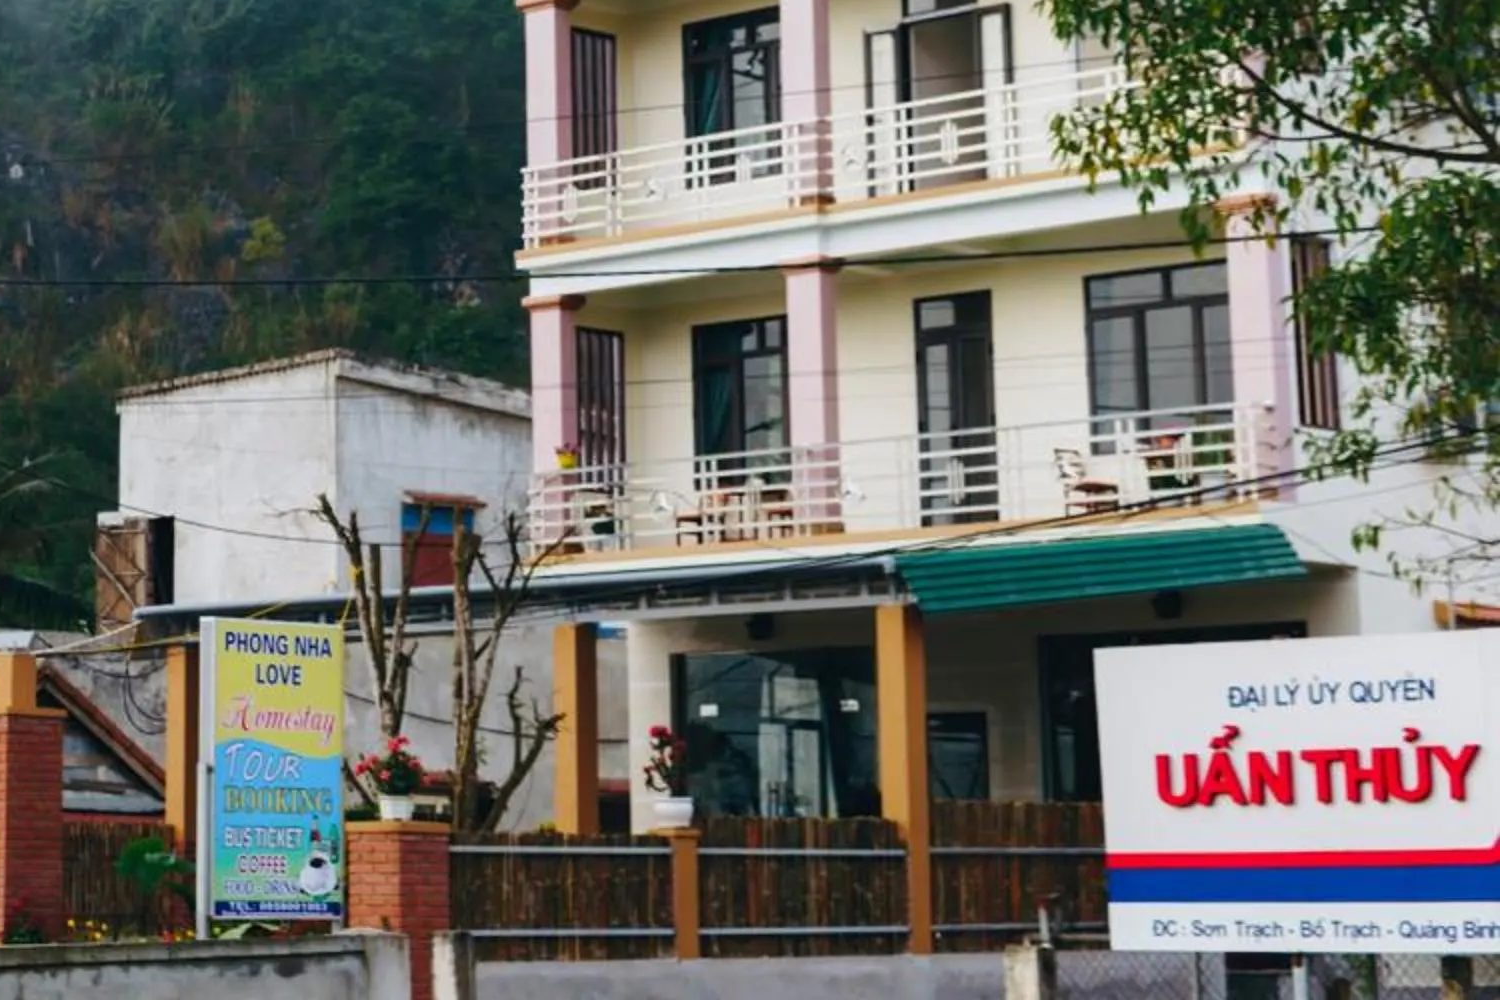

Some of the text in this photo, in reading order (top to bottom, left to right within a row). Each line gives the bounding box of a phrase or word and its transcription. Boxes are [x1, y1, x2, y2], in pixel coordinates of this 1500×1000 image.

[225, 631, 333, 658] PHONG NHA
[255, 663, 302, 686] LOVE
[1228, 686, 1267, 712] ĐẠI
[1274, 678, 1299, 706] LÝ
[222, 696, 336, 747] Homestay
[227, 743, 301, 781] TOUR
[1155, 724, 1480, 808] UẨN THỦY
[224, 785, 332, 814] BOOKING
[224, 827, 303, 850] BUS TICKET
[239, 855, 288, 874] COFFEE
[1235, 919, 1283, 943] Trạch
[1331, 919, 1381, 943] Trạch
